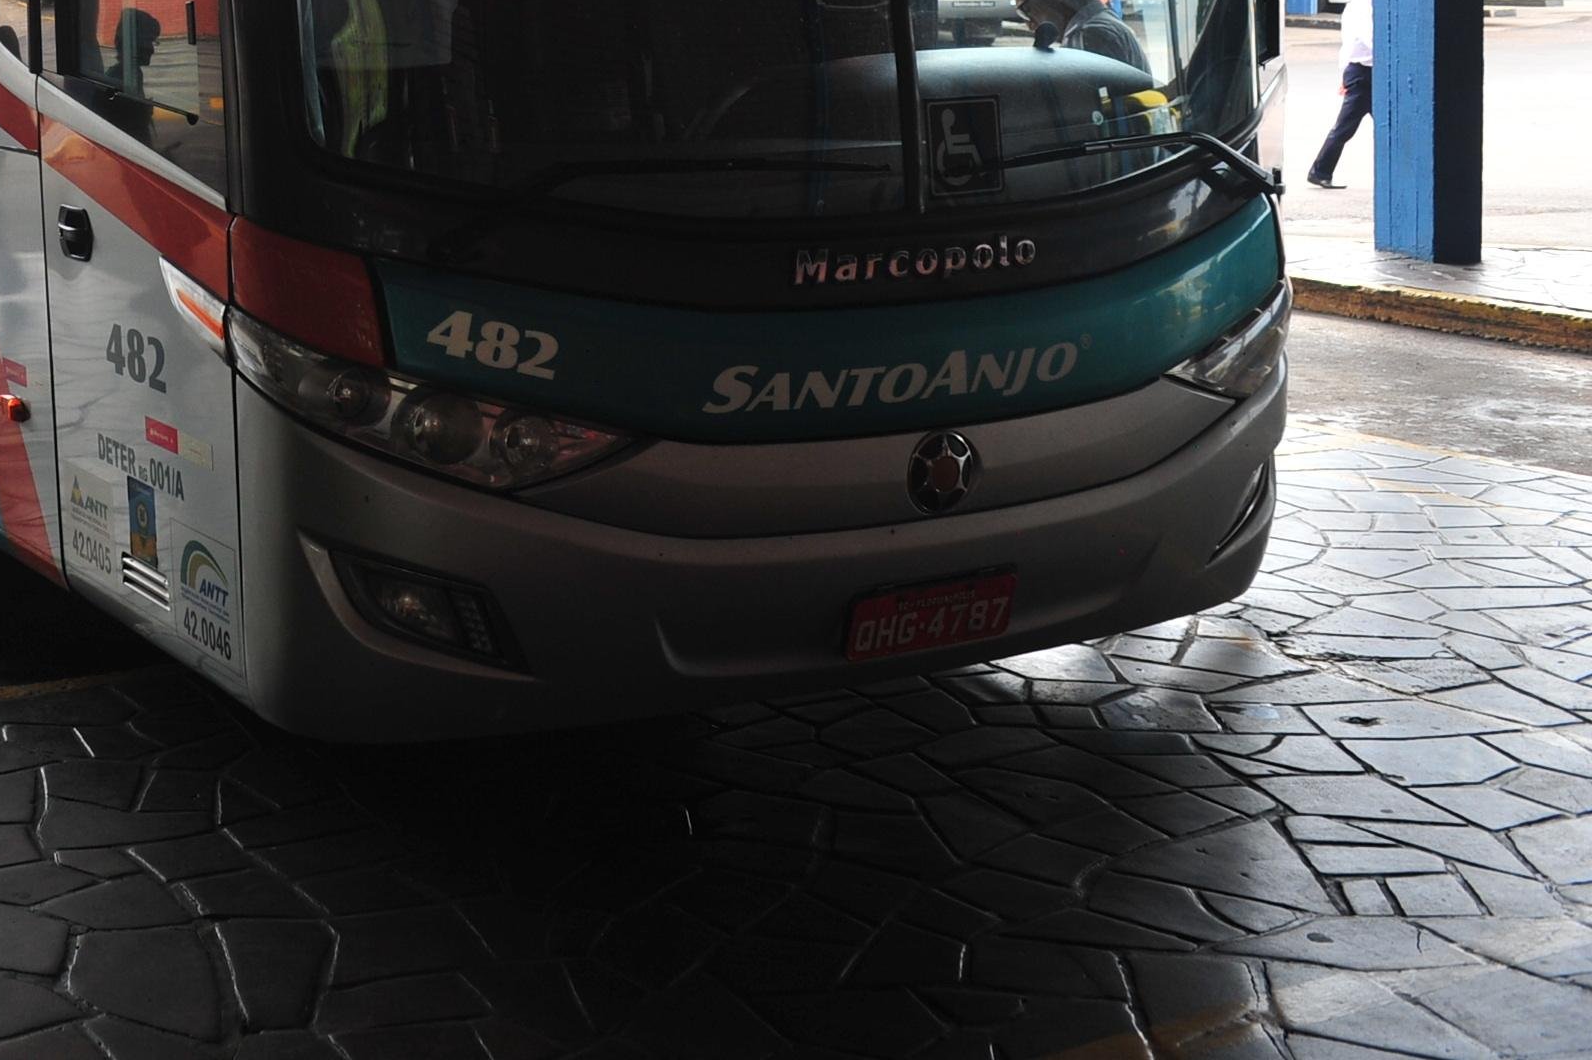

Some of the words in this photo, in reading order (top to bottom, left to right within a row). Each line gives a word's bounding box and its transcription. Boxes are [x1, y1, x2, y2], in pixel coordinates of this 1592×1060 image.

[793, 234, 1039, 286] Marcopolo
[105, 323, 168, 393] 482
[425, 309, 560, 381] 482
[97, 432, 136, 477] DETER
[149, 457, 185, 502] 001/A
[84, 495, 109, 521] ANTT
[199, 578, 229, 607] ANTT
[183, 606, 232, 661] 42.0046
